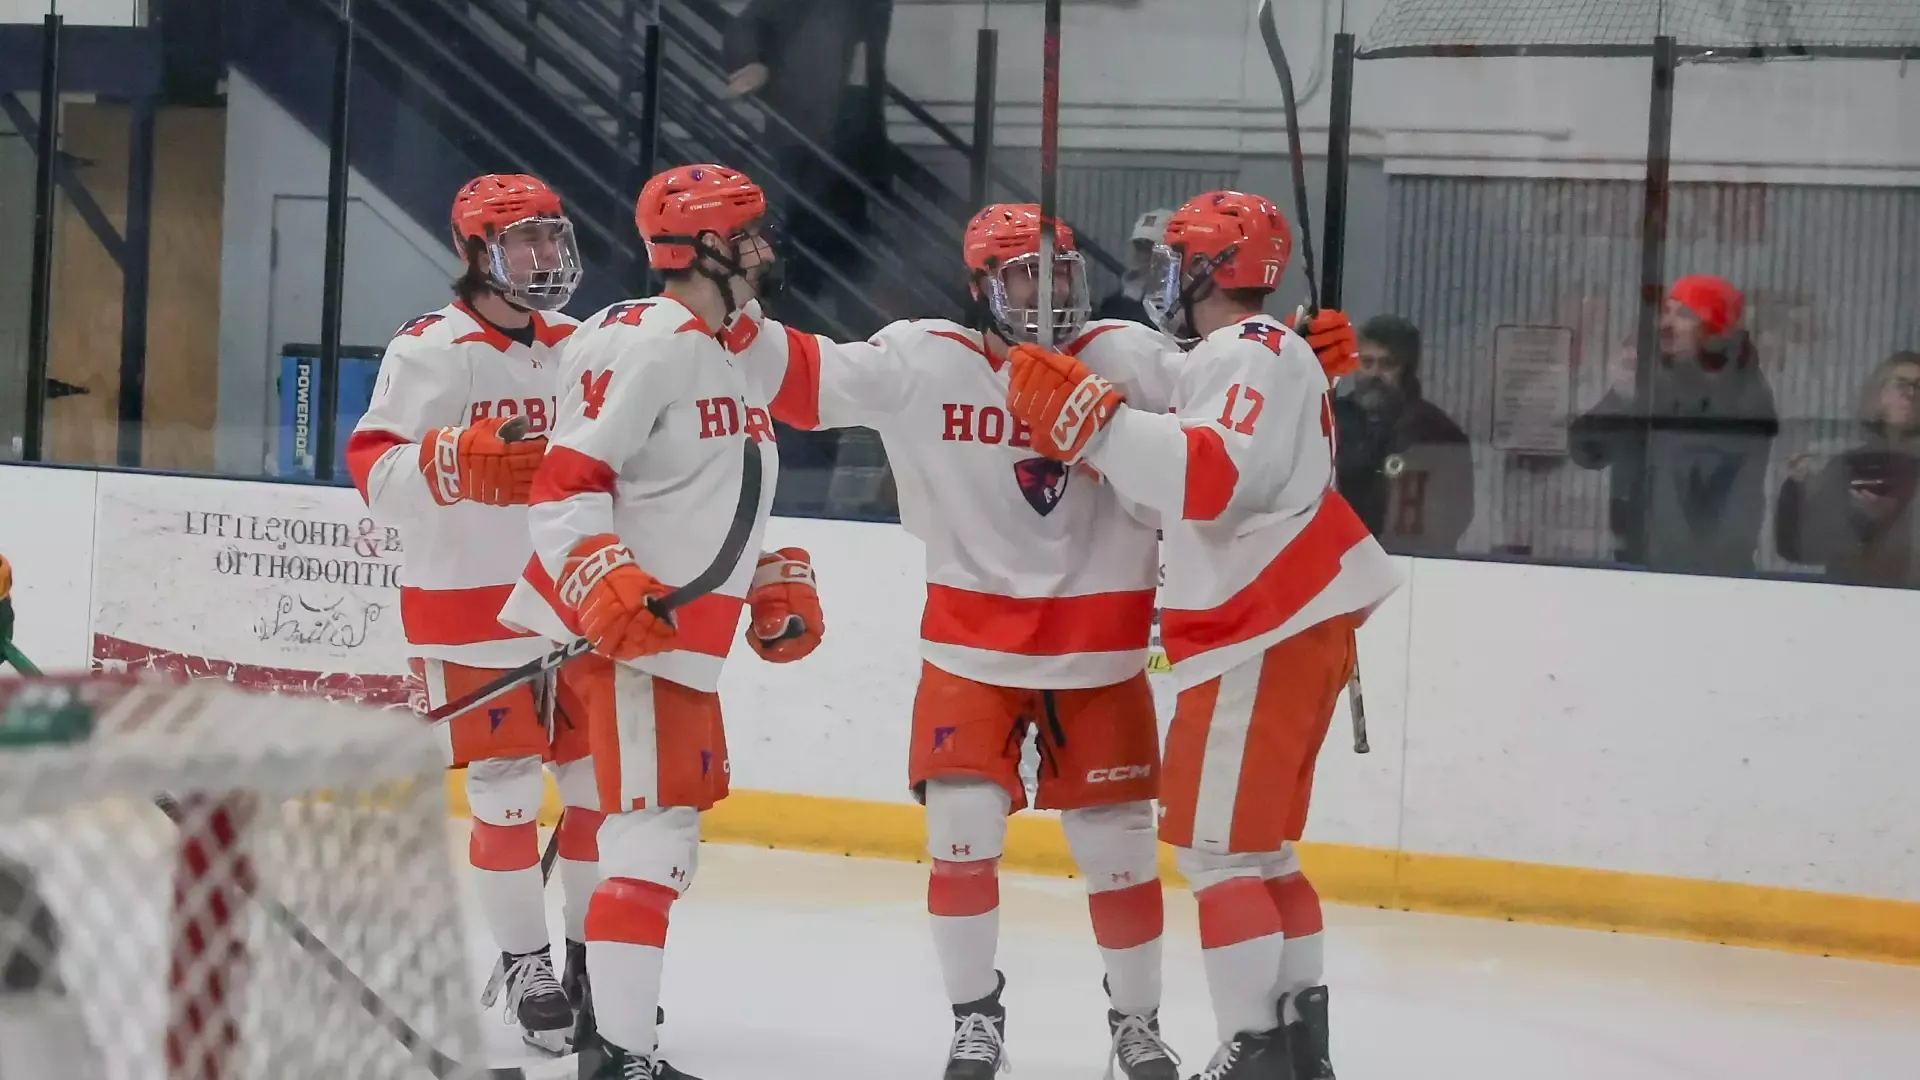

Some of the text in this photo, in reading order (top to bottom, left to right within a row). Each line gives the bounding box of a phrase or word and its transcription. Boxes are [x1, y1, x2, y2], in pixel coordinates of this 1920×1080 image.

[1264, 265, 1278, 284] 17
[1238, 322, 1285, 356] H
[296, 364, 310, 457] POWERADE
[581, 369, 614, 420] 14
[1216, 383, 1264, 435] 17
[354, 517, 382, 558] &
[1086, 764, 1151, 783] CCM
